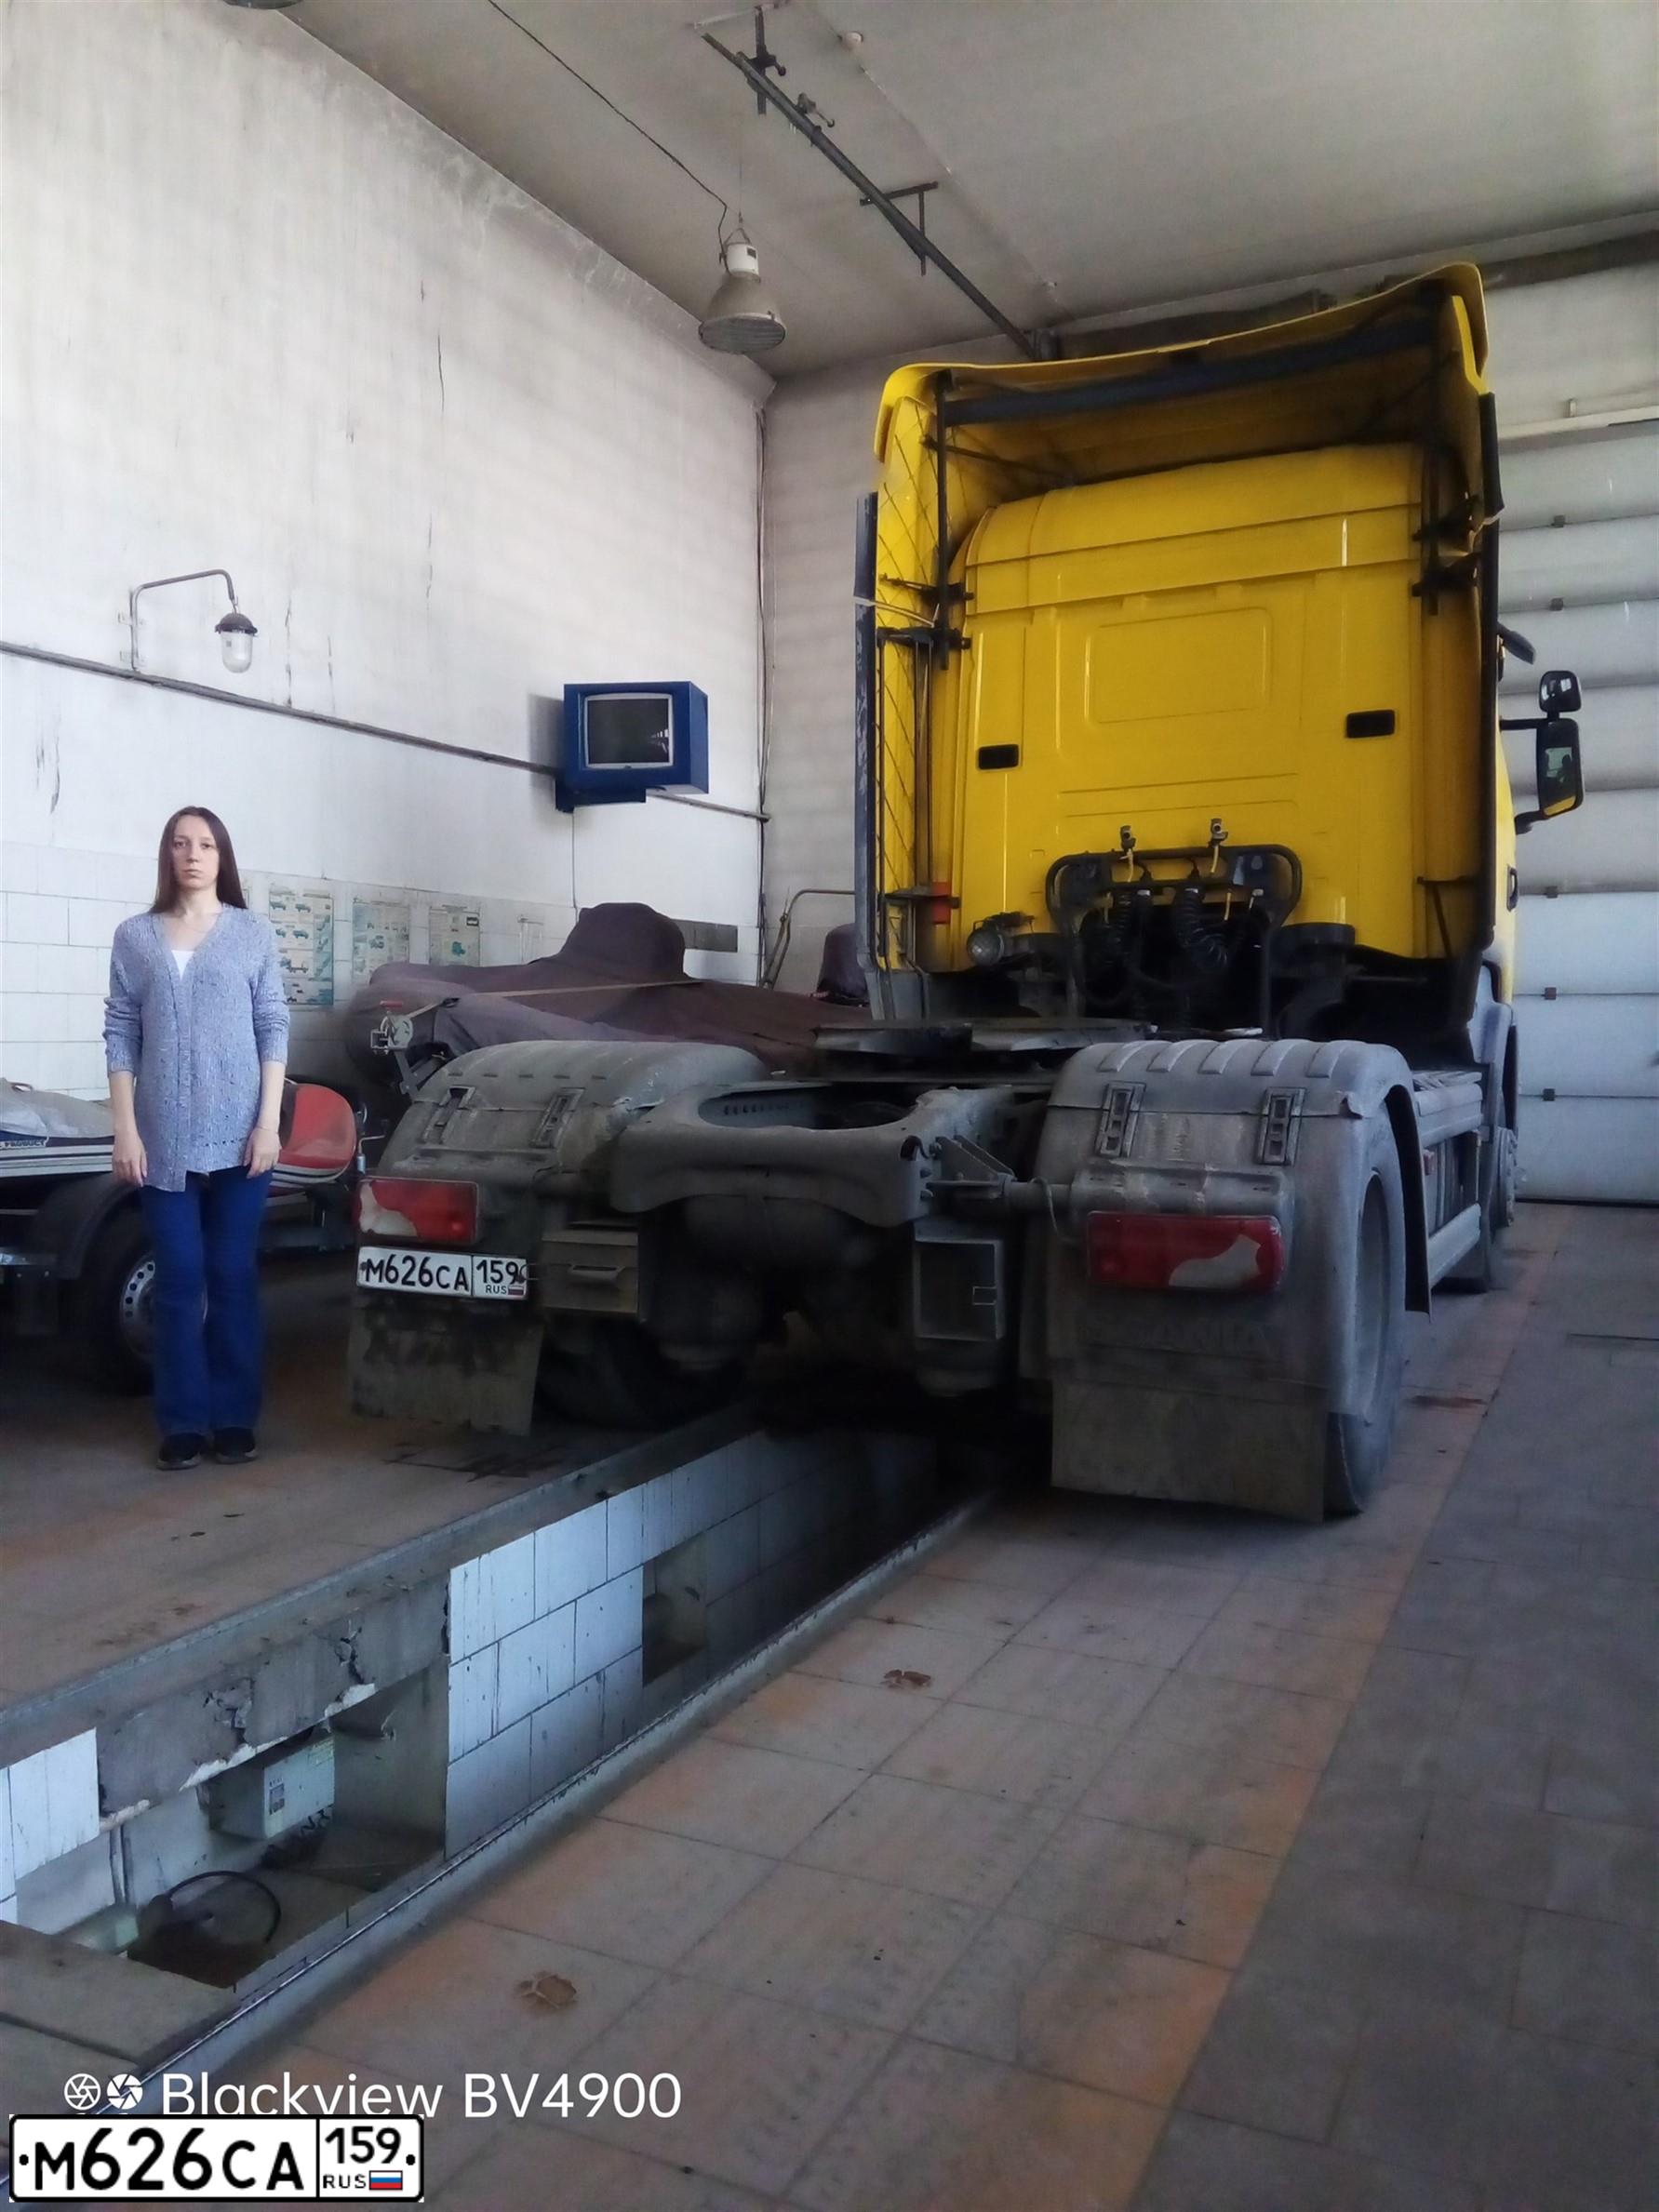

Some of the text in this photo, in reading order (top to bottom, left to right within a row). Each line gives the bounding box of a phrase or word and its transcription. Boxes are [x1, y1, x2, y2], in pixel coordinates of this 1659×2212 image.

[365, 1253, 521, 1292] M626CA 159
[485, 1285, 507, 1295] RUS
